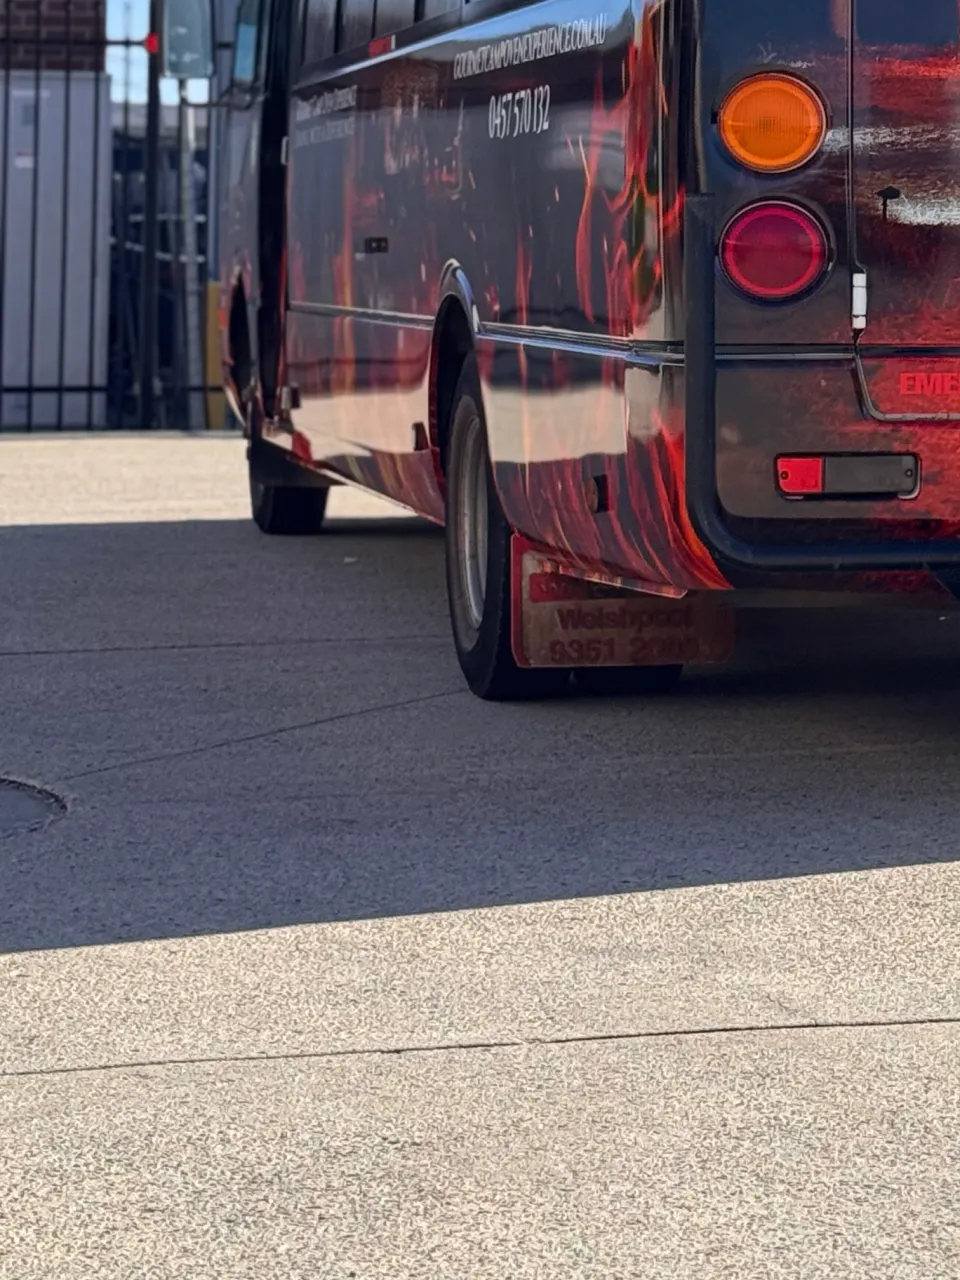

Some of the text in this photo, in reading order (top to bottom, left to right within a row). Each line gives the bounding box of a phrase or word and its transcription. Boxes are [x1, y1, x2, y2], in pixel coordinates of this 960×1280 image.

[488, 84, 551, 140] 0457 570 132
